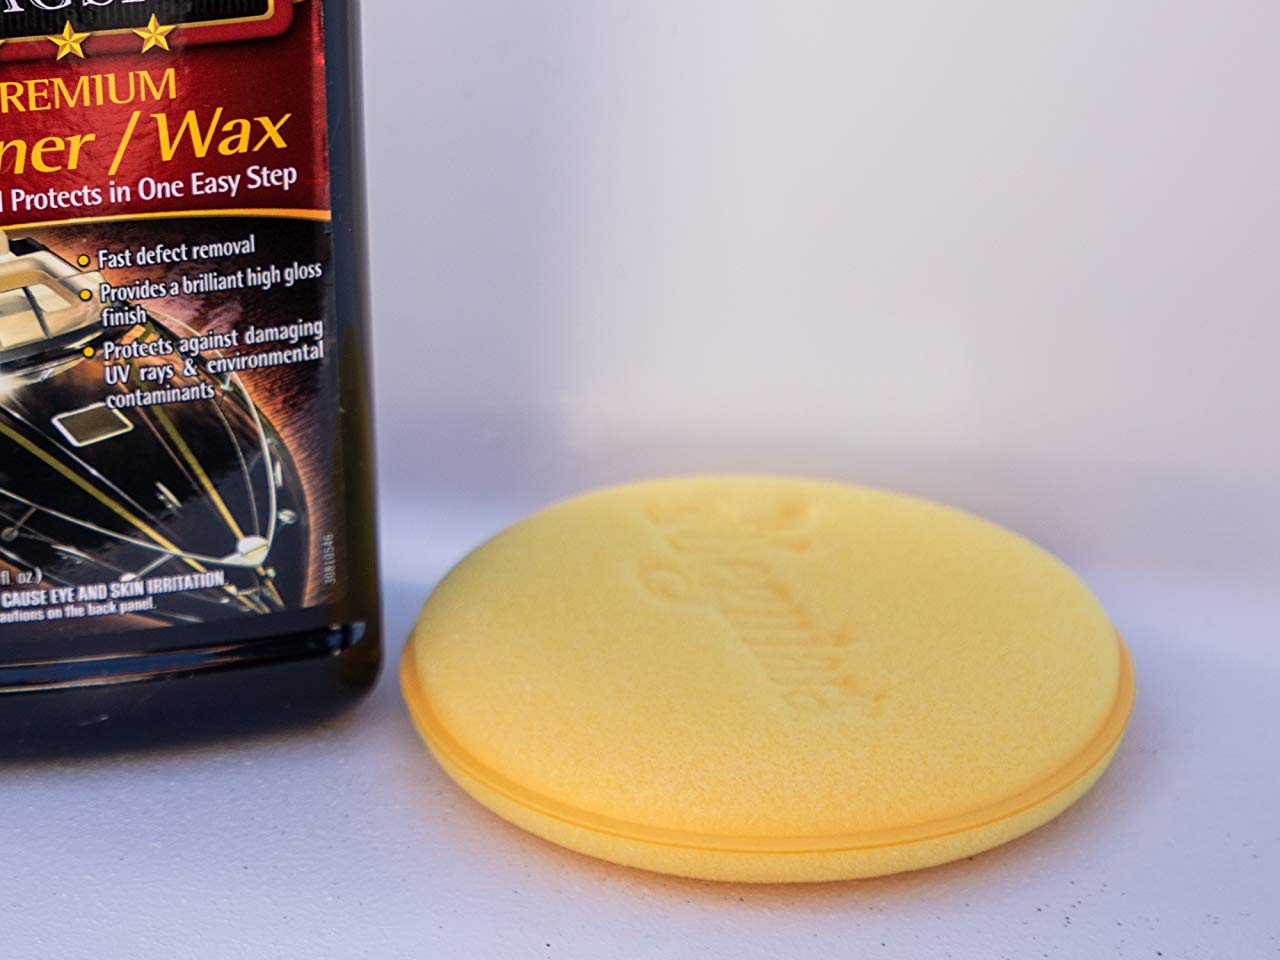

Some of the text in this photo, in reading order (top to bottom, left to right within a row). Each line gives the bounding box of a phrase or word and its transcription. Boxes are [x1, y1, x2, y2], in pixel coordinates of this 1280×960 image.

[11, 183, 101, 211] Protects
[109, 185, 131, 206] in
[138, 177, 184, 201] One
[192, 172, 241, 197] Easy
[246, 164, 297, 190] Step
[98, 234, 255, 269] Fast defect removal
[100, 261, 323, 303] Provides a brilliant high gloss
[101, 304, 147, 327] finish
[103, 318, 323, 360] Protects against damaging
[104, 342, 324, 385] UV rays & environmental
[106, 382, 215, 409] contaminants
[1, 590, 48, 608] CAUSE
[50, 587, 76, 604] EYE
[77, 583, 108, 602] AND
[110, 580, 144, 599] SKIN
[47, 606, 63, 619] on
[65, 604, 85, 618] the
[87, 601, 117, 616] back
